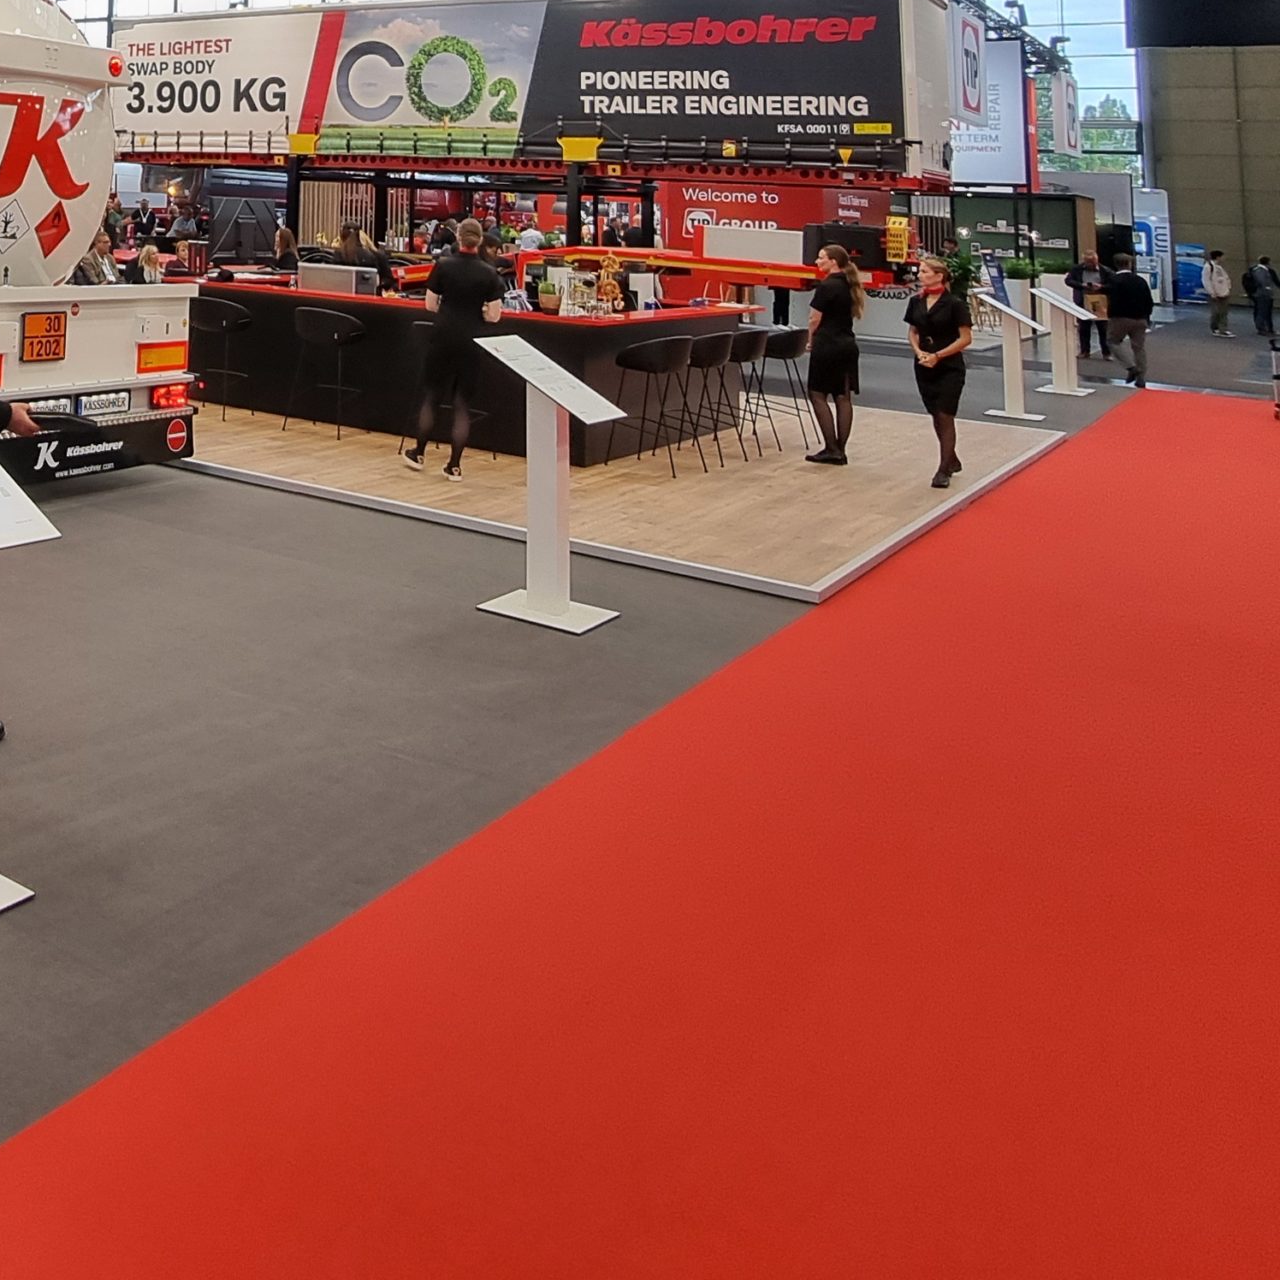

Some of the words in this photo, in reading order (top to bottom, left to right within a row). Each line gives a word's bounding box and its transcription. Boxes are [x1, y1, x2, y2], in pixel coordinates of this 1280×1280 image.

[580, 15, 877, 49] Kässbohrer
[127, 43, 155, 57] THE
[159, 38, 233, 56] LIGHTEST
[127, 61, 168, 76] SWAP
[172, 59, 215, 75] BODY
[964, 48, 978, 89] TIP
[580, 70, 730, 90] PIONEERING
[126, 79, 221, 113] 3.900
[232, 77, 287, 113] KG
[580, 95, 678, 114] TRAILER
[685, 95, 869, 116] ENGINEERING
[988, 83, 1001, 130] REPAIR
[777, 124, 804, 133] KFSA
[967, 134, 999, 143] TERM
[954, 145, 1001, 153] QUIPMENT
[682, 187, 757, 203] Welcome
[761, 191, 779, 204] to
[45, 316, 61, 333] 30
[29, 338, 60, 358] 1202
[33, 441, 60, 470] K
